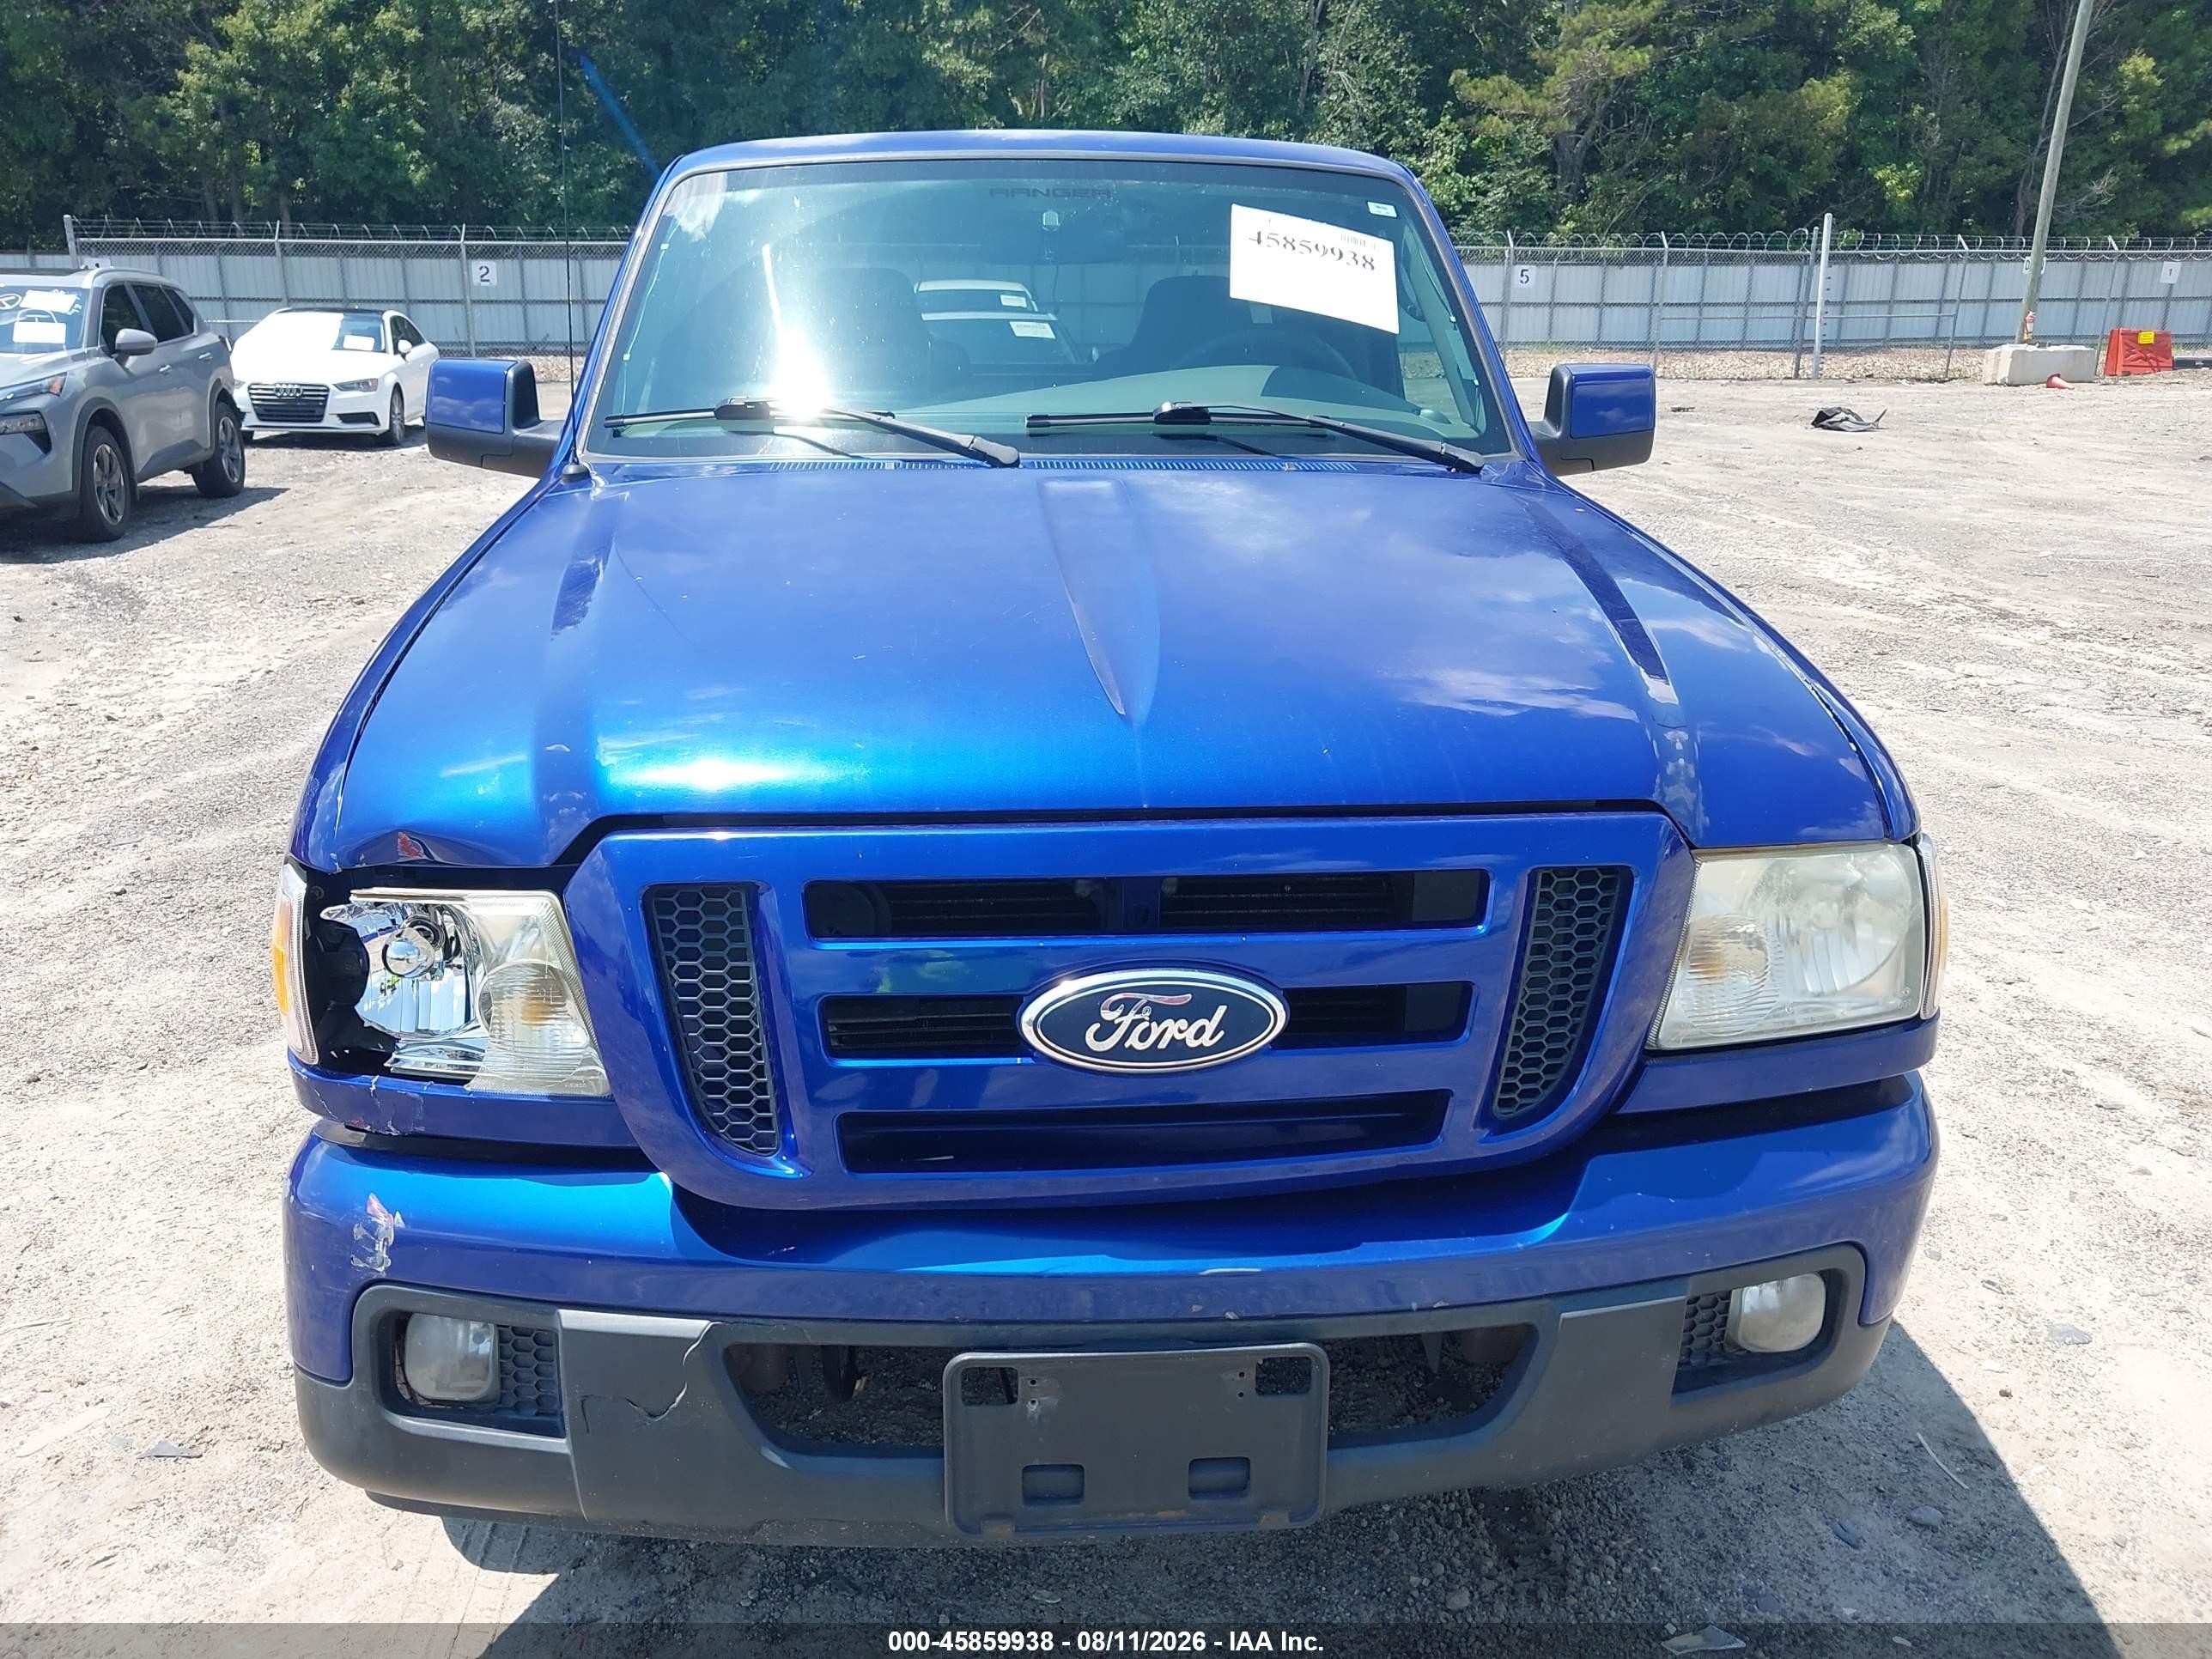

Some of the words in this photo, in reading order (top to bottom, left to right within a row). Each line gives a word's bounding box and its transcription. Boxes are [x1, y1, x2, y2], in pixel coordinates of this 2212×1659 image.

[988, 183, 1113, 198] RANGER
[1248, 229, 1376, 271] 45859938
[478, 265, 490, 283] 2
[1520, 268, 1530, 284] 5
[1085, 991, 1229, 1053] Ford
